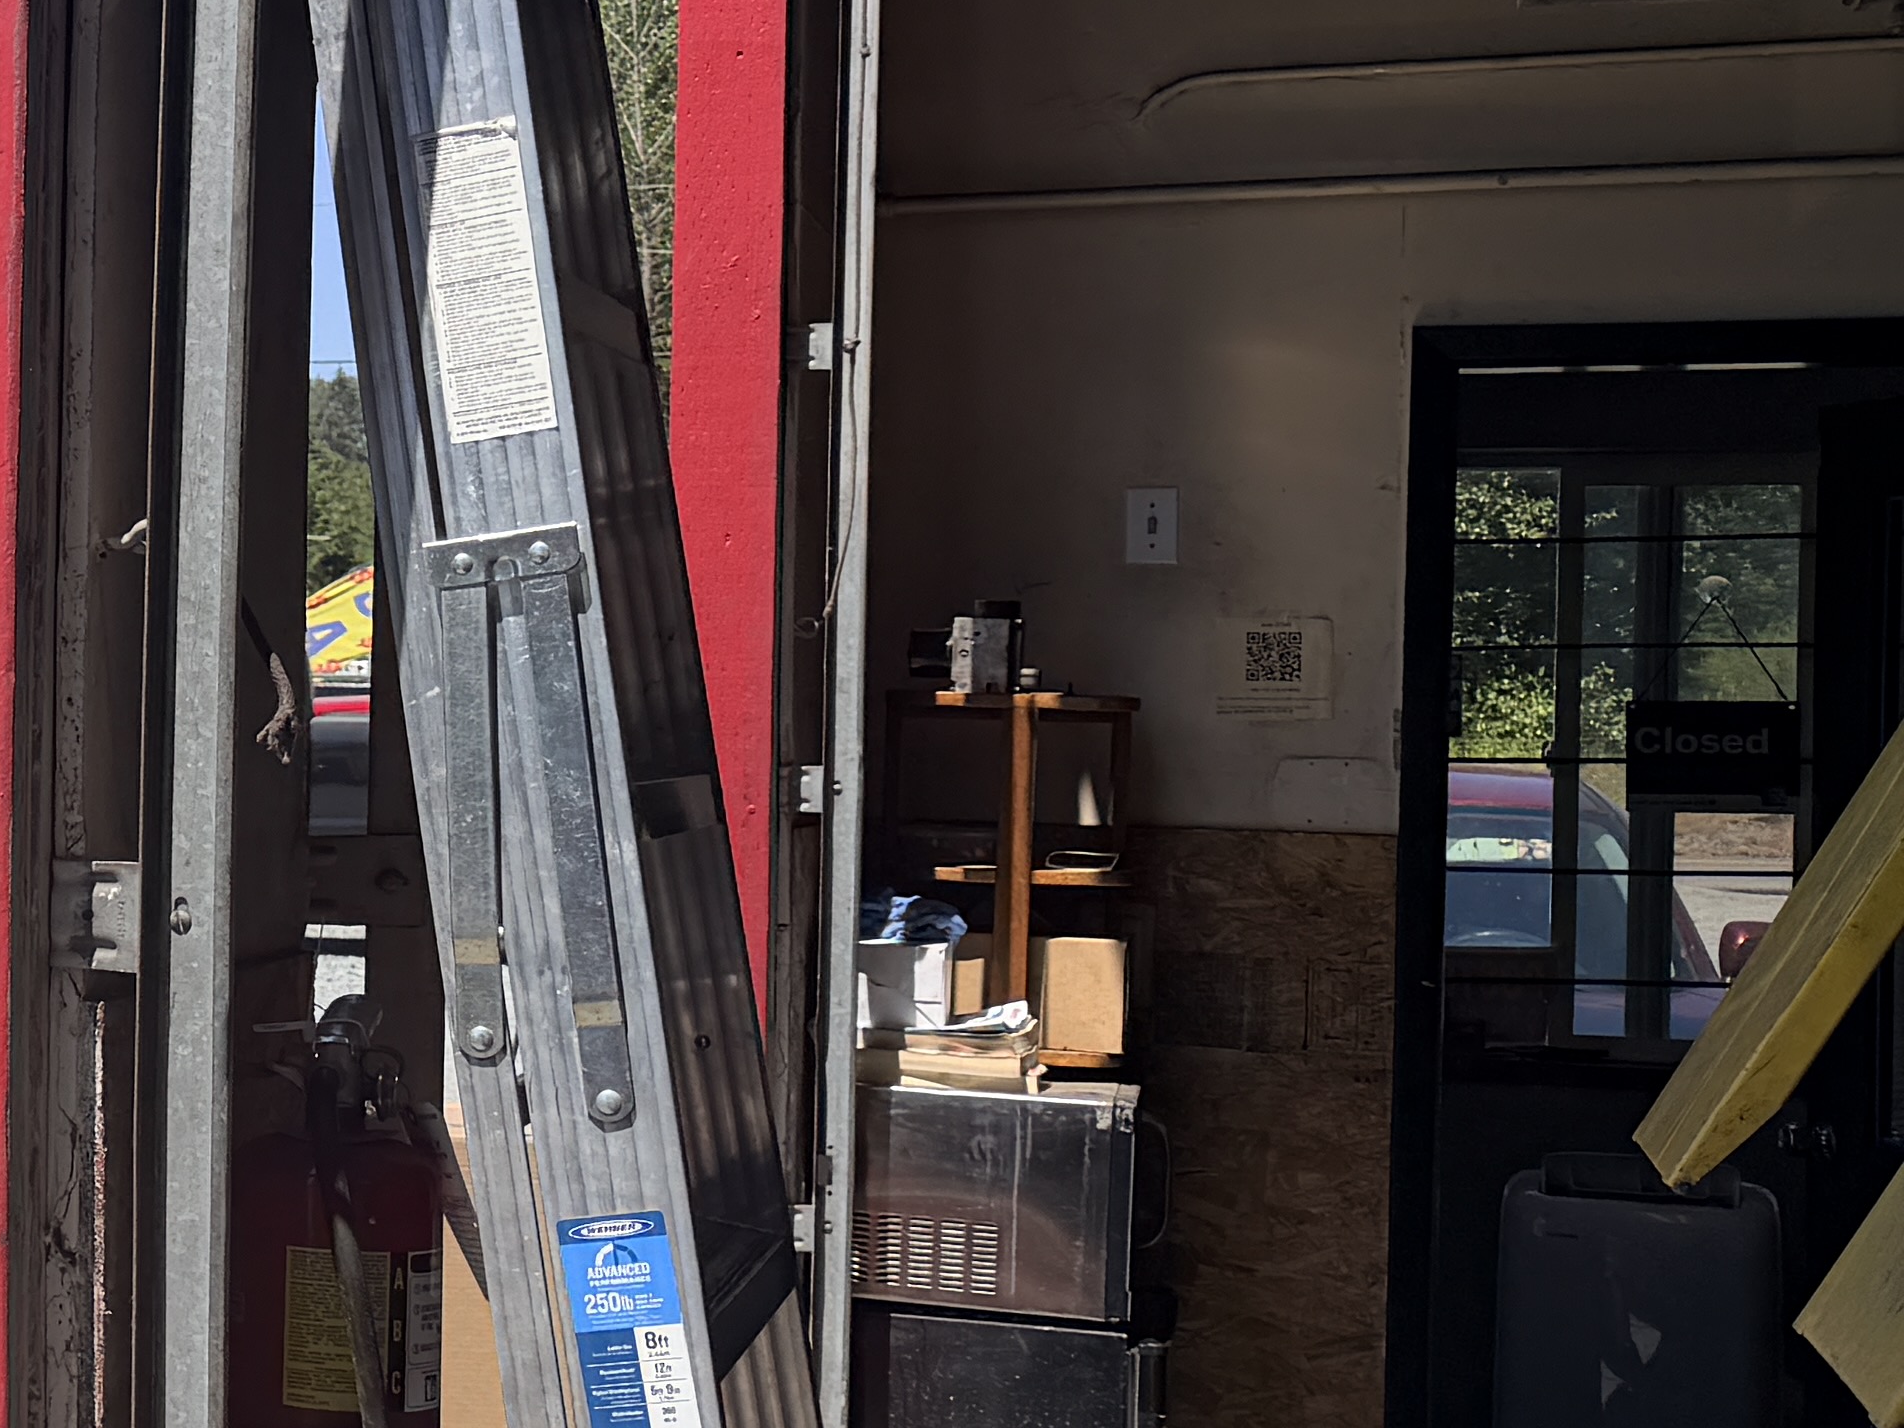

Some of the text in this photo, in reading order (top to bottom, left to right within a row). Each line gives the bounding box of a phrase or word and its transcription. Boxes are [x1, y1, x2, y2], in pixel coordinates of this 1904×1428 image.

[1634, 726, 1769, 754] Closed
[394, 1267, 404, 1290] A
[587, 1262, 651, 1280] ADVANCED
[392, 1320, 402, 1342] B
[391, 1371, 401, 1395] C
